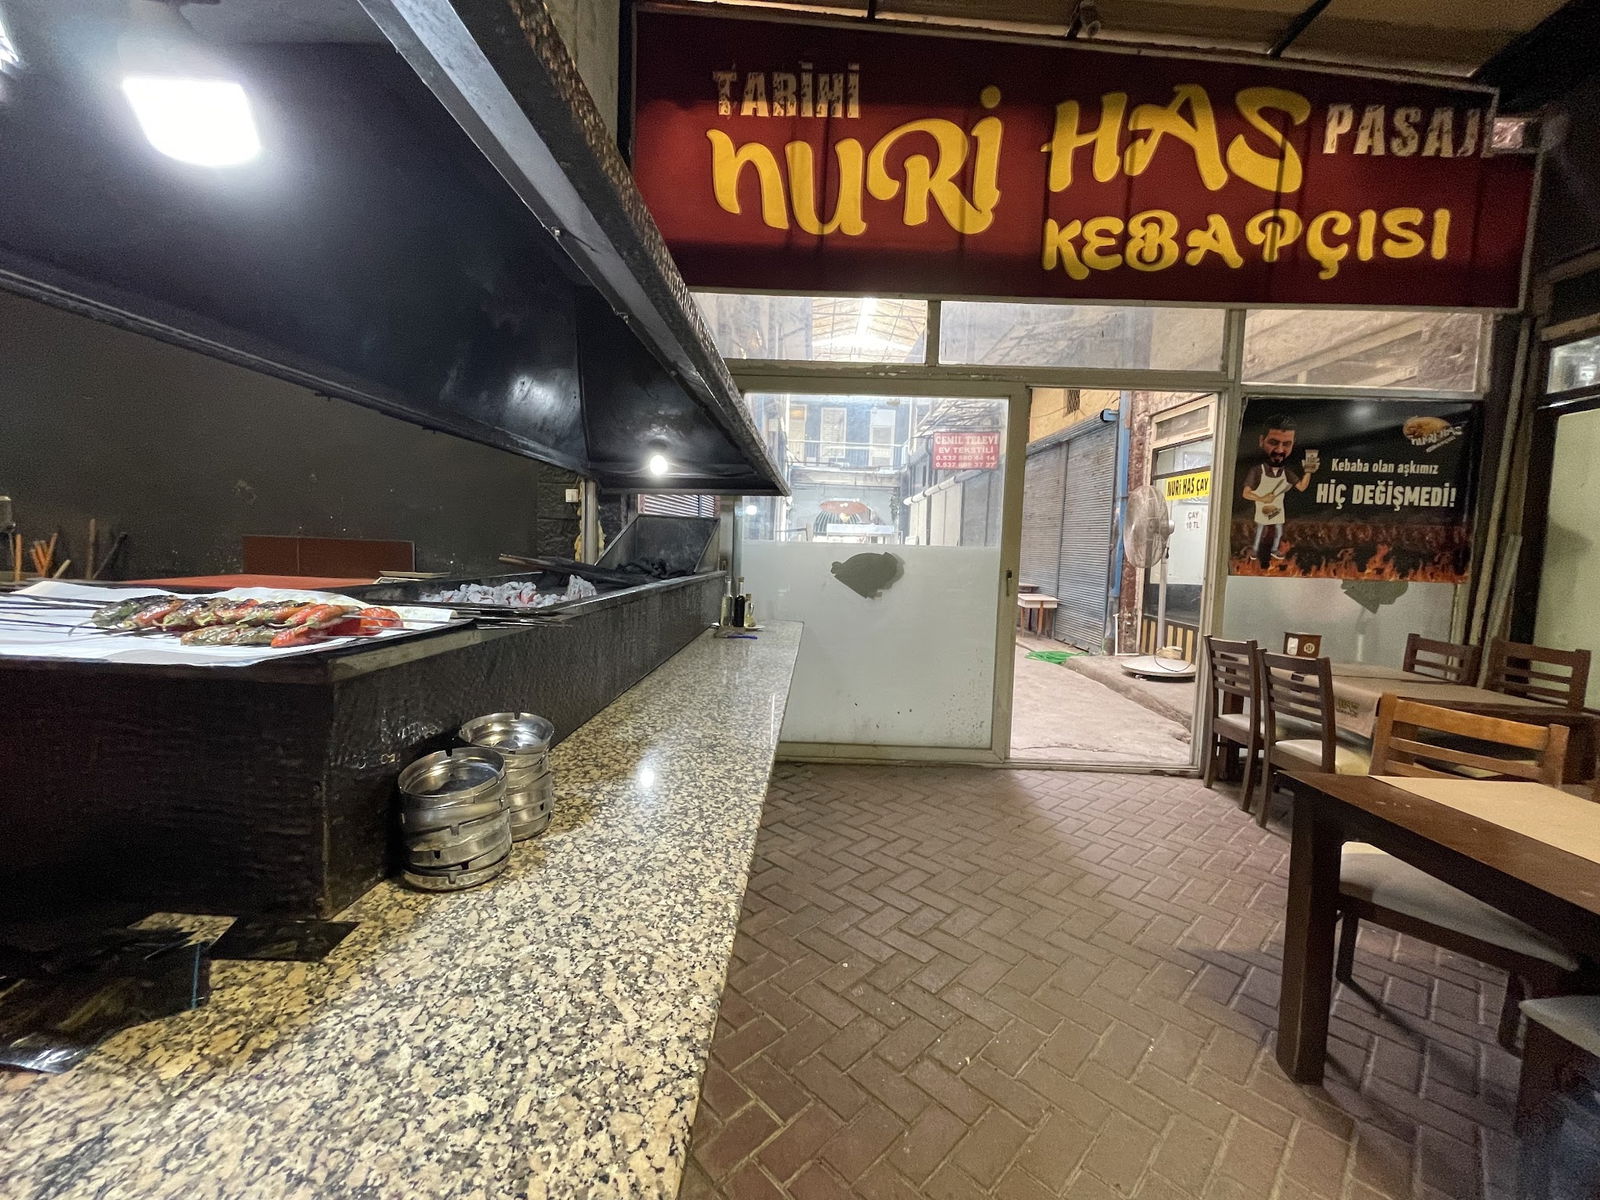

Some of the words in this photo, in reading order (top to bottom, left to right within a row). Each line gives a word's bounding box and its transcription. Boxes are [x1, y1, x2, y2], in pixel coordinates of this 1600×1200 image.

[1040, 83, 1313, 193] HAS
[1041, 206, 1451, 281] KEBAPÇISI
[938, 446, 950, 454] EV
[1331, 458, 1370, 473] Kebaba
[1372, 460, 1394, 473] olan
[1397, 461, 1439, 477] aşkımız
[1182, 477, 1195, 495] HAS
[1196, 477, 1209, 496] ÇAY
[1316, 478, 1347, 510] HİÇ
[1352, 480, 1456, 512] DEĞİŞMEDİ!
